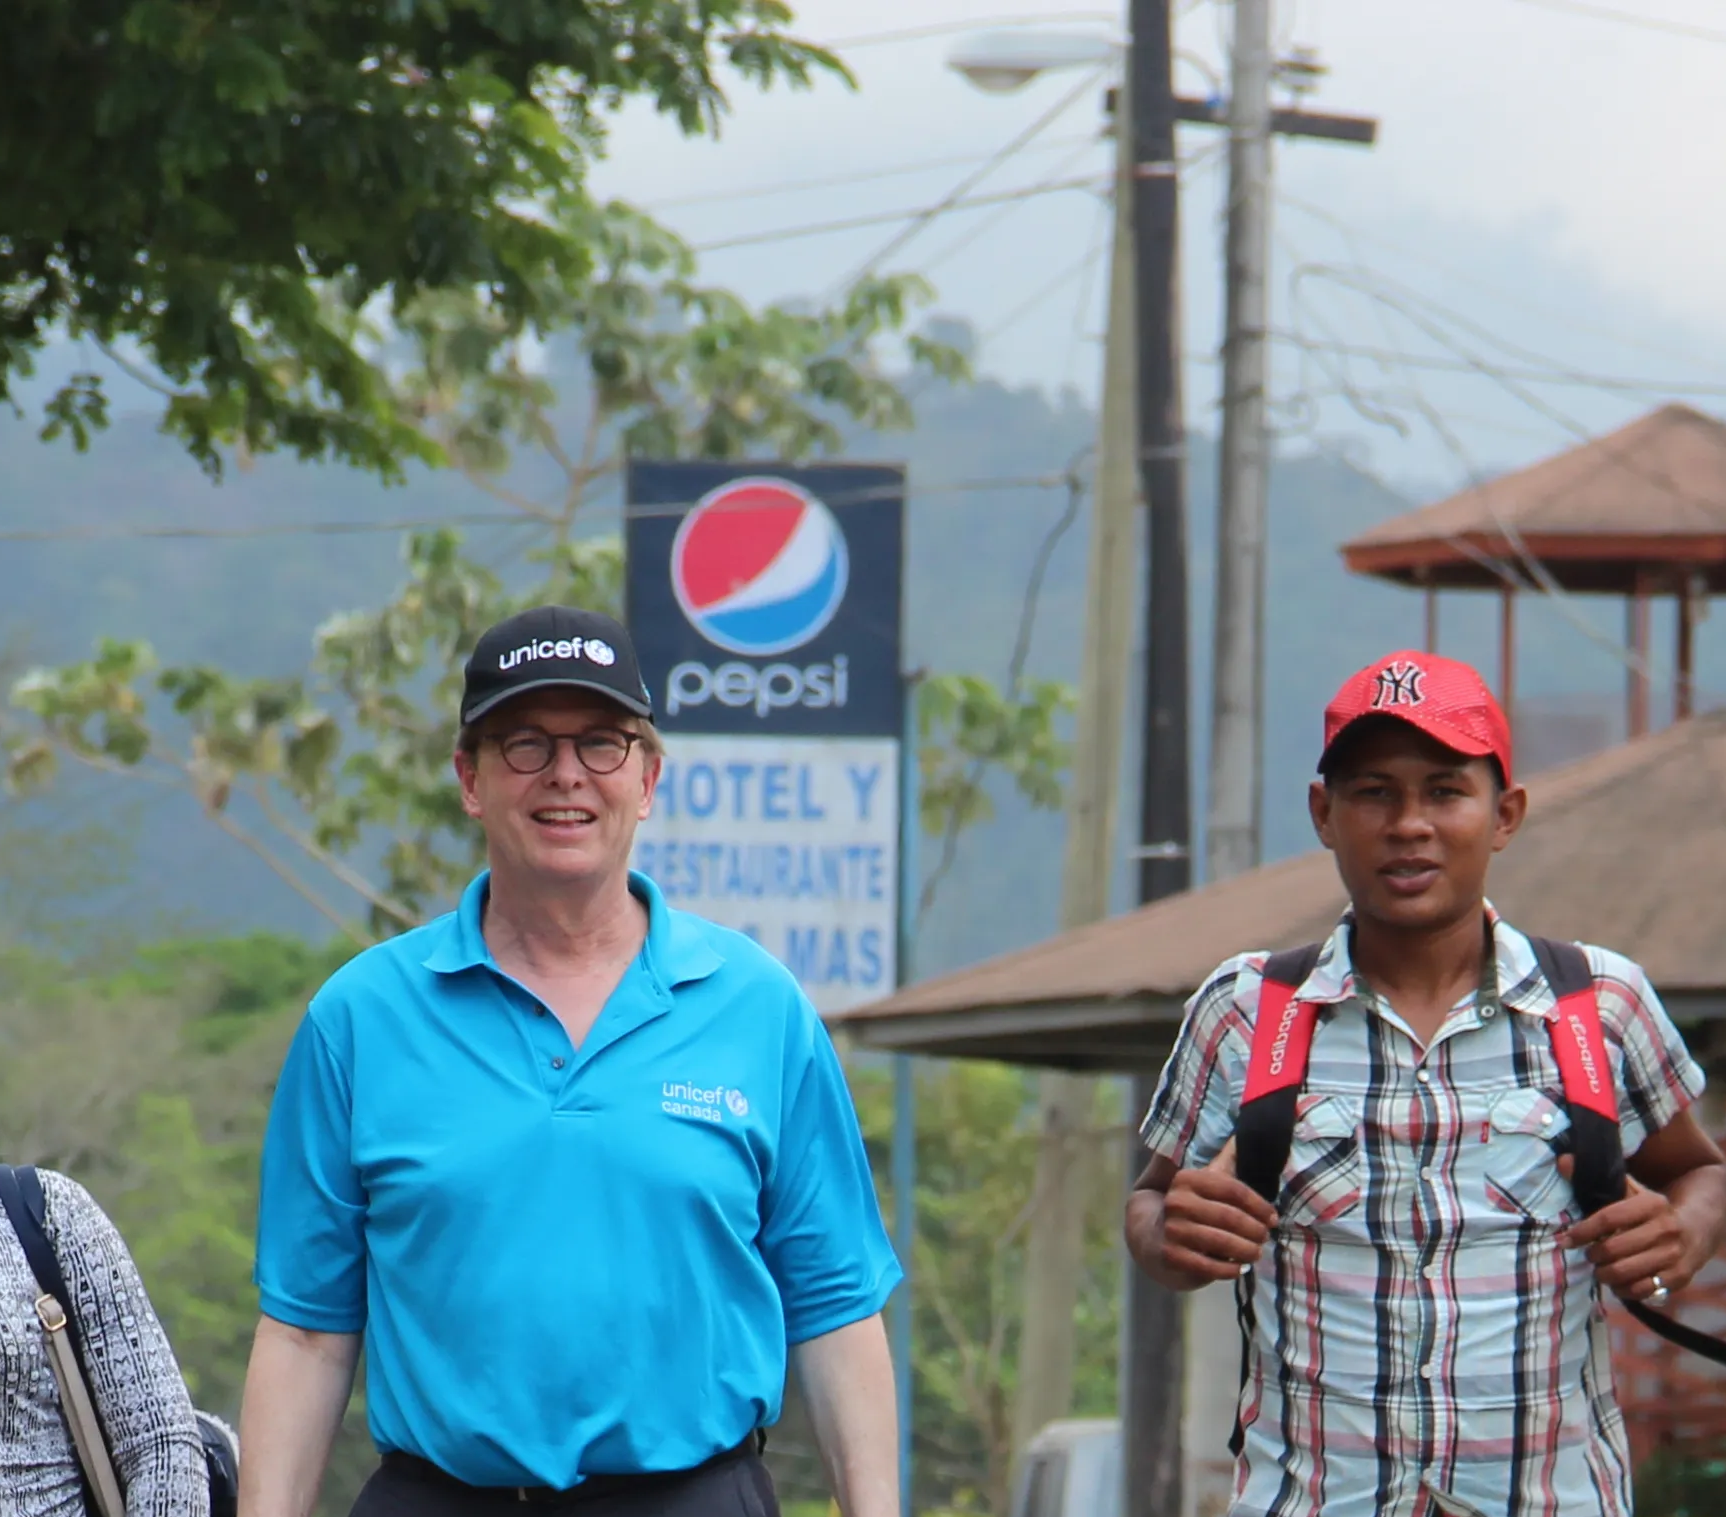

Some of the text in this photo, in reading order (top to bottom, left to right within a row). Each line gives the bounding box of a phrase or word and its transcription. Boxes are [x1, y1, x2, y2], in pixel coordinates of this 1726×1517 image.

[499, 637, 583, 670] unicef
[666, 653, 849, 717] pepsi
[844, 763, 881, 822] Y
[1269, 1001, 1299, 1076] adibags
[660, 1100, 722, 1122] canada
[661, 1081, 724, 1105] unicef
